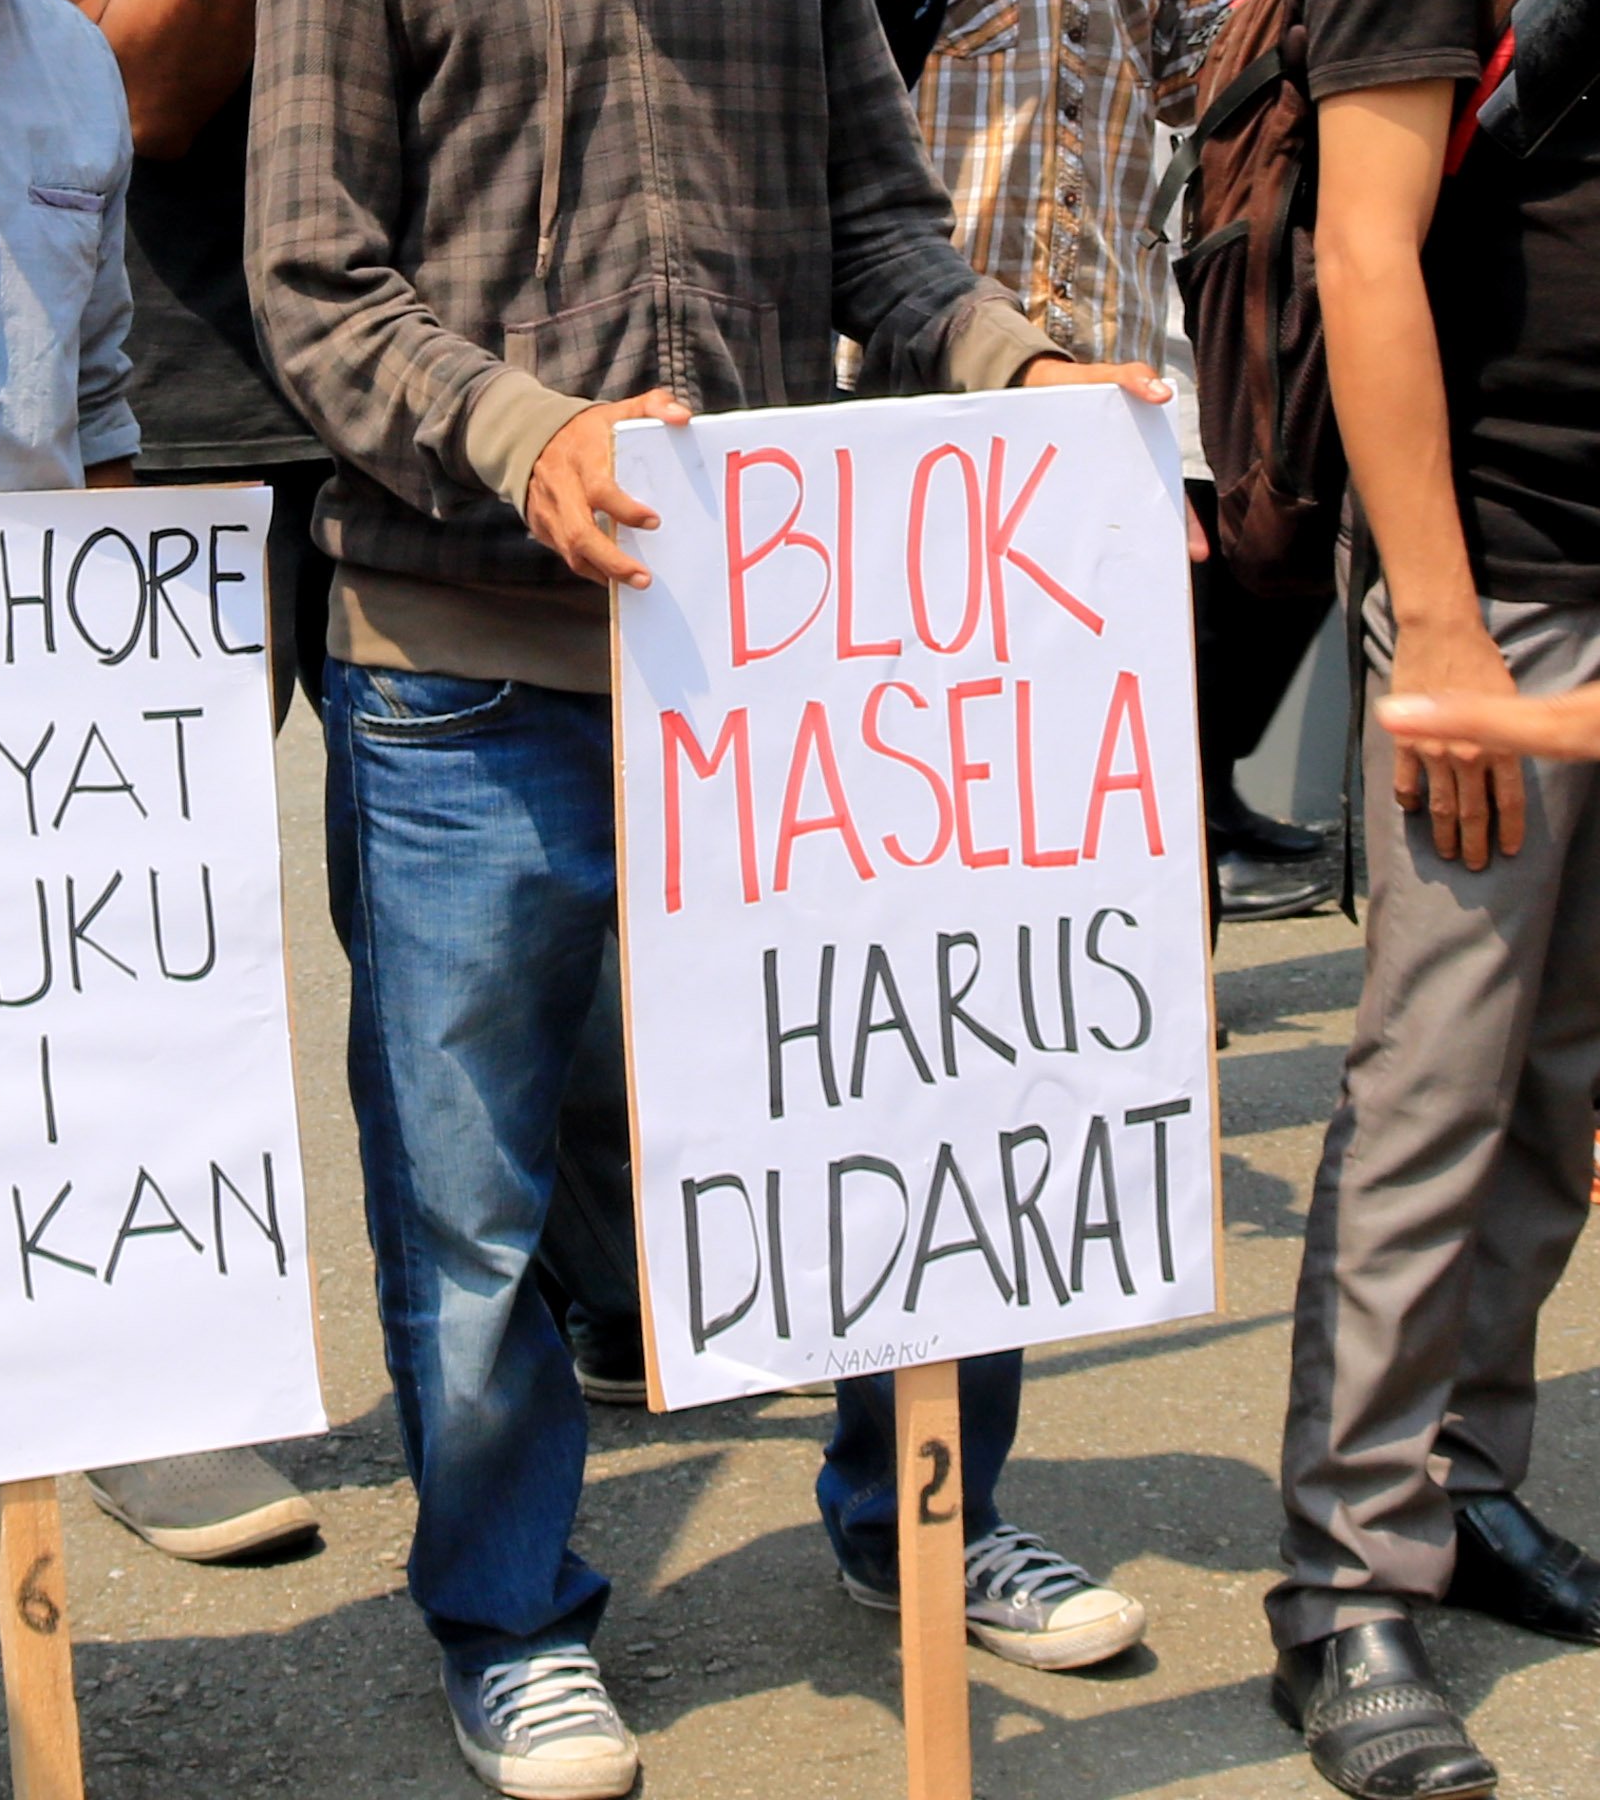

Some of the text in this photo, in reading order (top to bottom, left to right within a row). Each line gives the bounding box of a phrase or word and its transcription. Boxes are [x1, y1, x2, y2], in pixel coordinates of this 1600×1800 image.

[724, 435, 1104, 668] BLOK
[659, 670, 1165, 914] MASELA
[762, 907, 1152, 1120] HARUS
[918, 1439, 957, 1525] 2
[16, 1553, 61, 1636] 6
